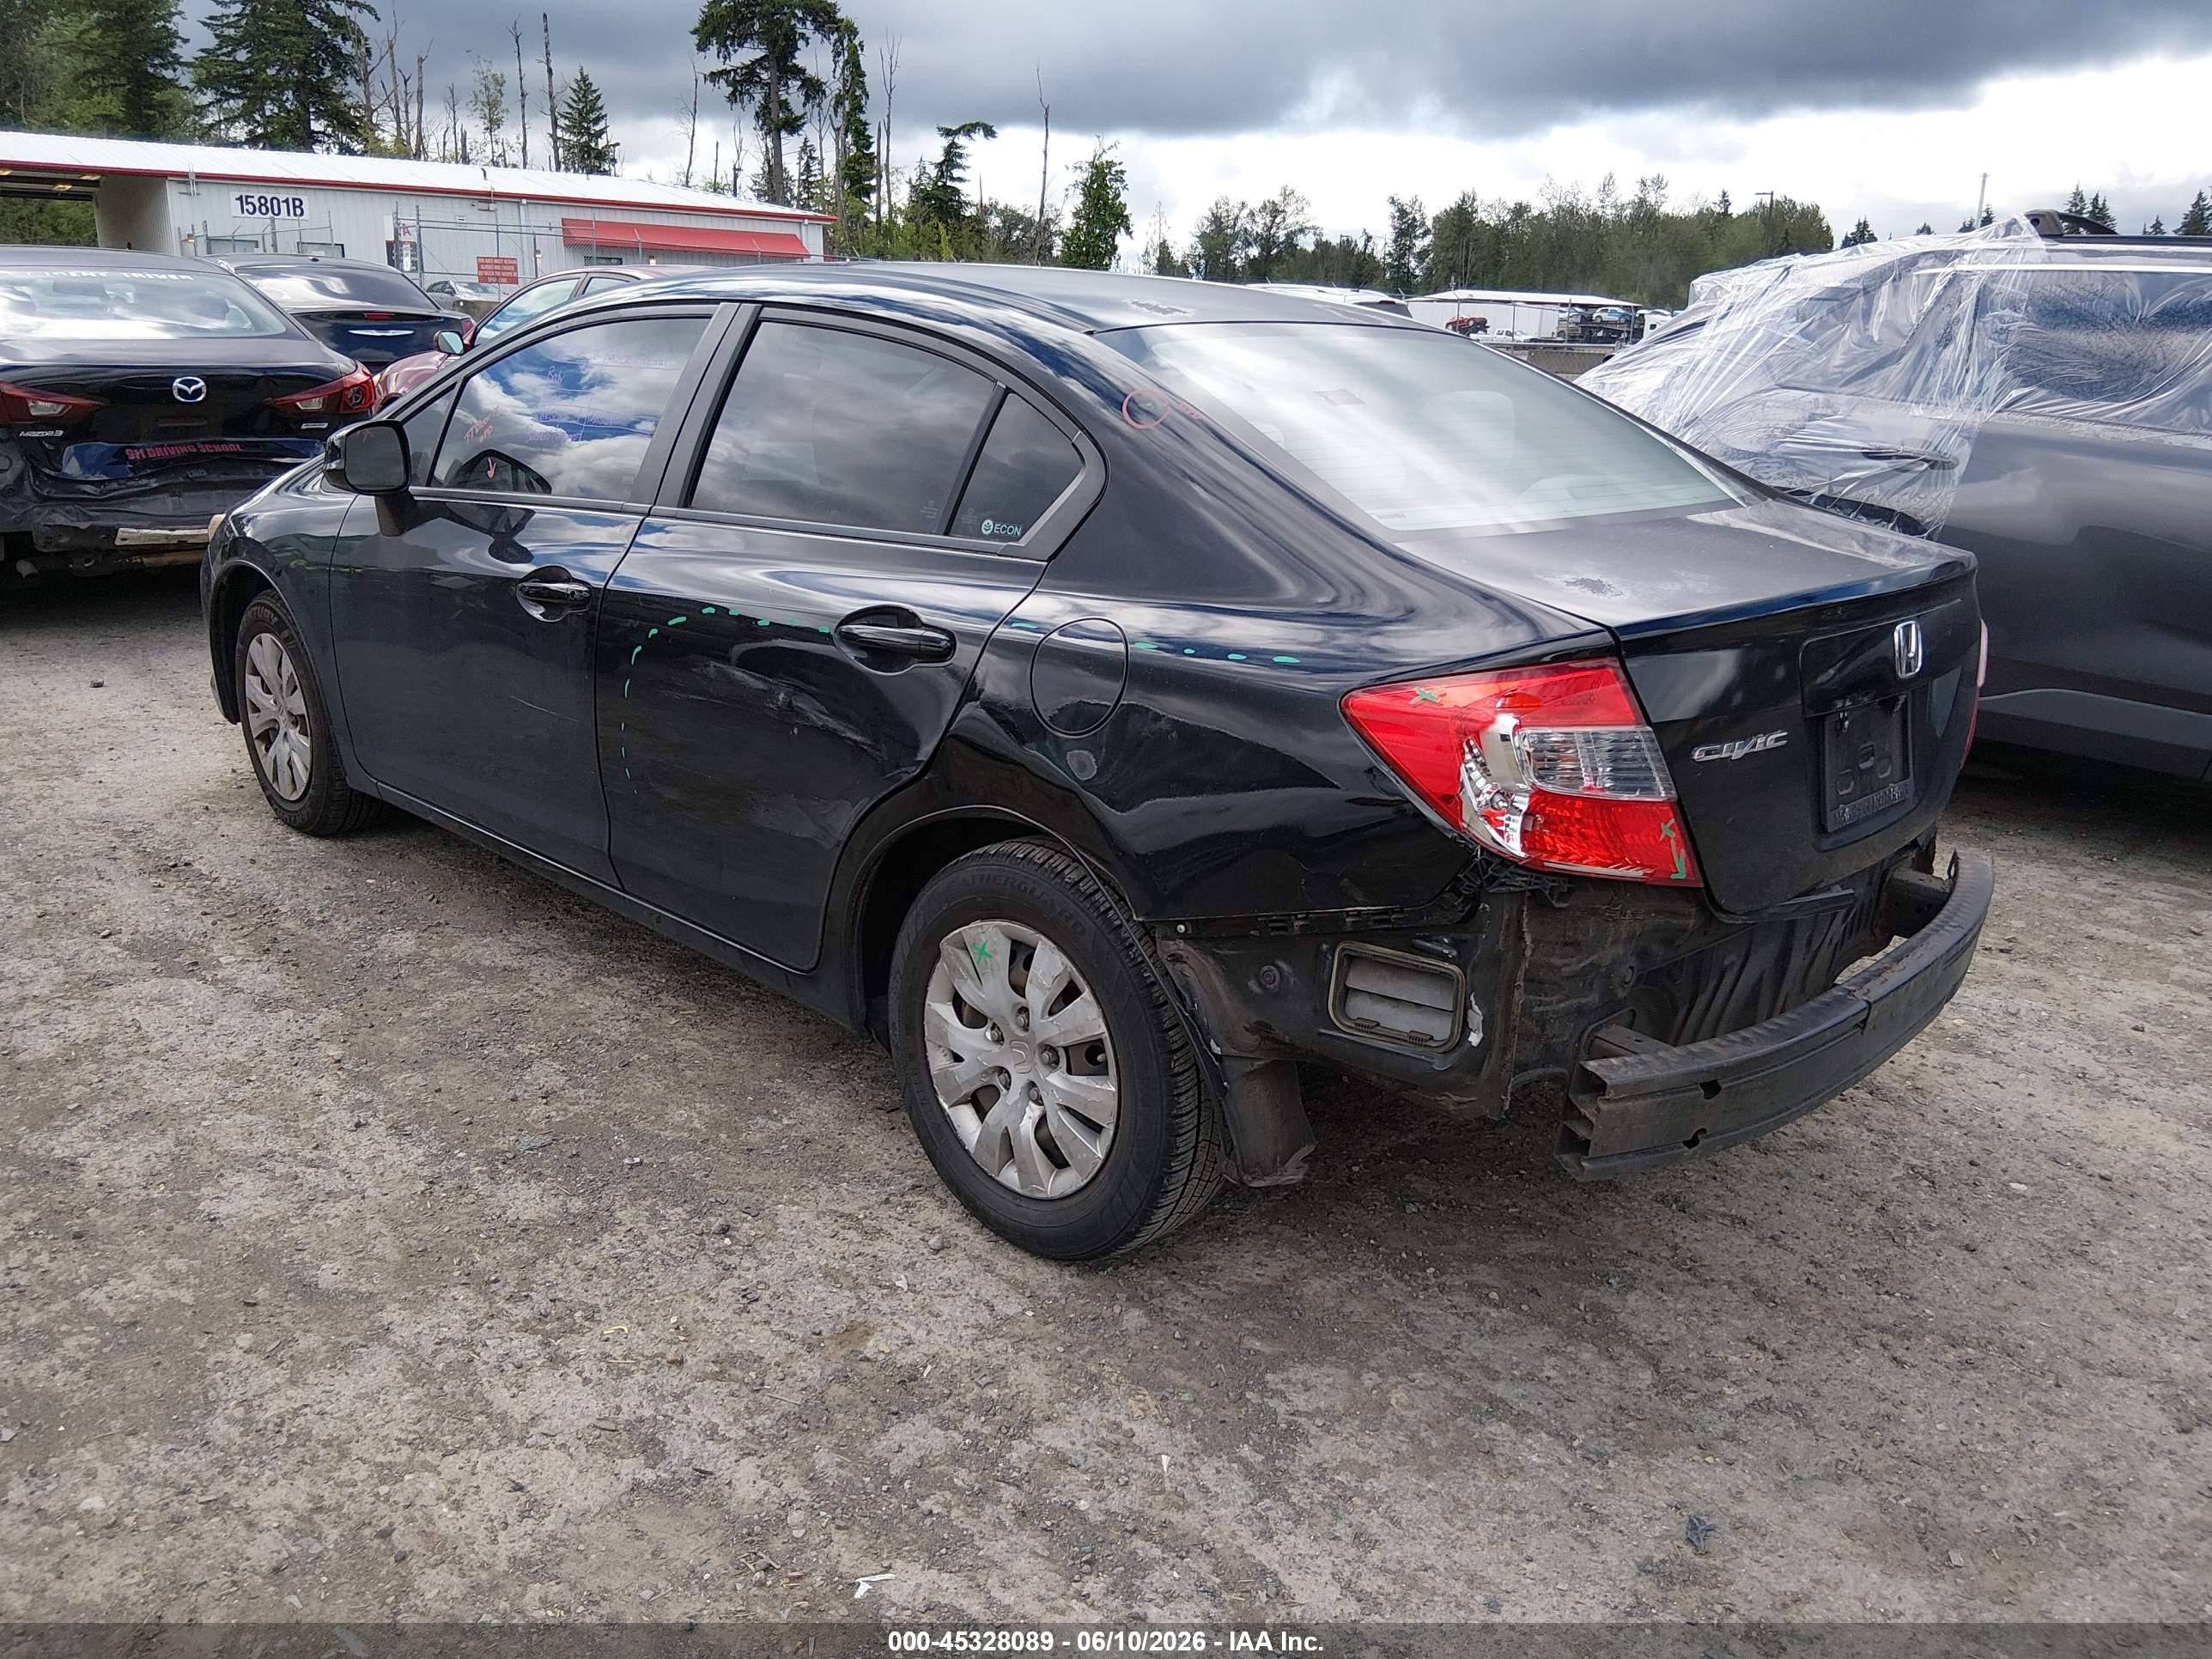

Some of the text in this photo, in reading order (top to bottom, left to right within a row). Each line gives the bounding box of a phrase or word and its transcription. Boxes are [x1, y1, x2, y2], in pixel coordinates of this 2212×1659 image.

[234, 194, 305, 217] 15801B
[147, 444, 198, 458] DRIVING
[198, 443, 242, 453] SCHOOL
[994, 522, 1022, 537] ECON
[1692, 729, 1789, 763] CIVIC
[942, 872, 1087, 935] EATHERGUARD
